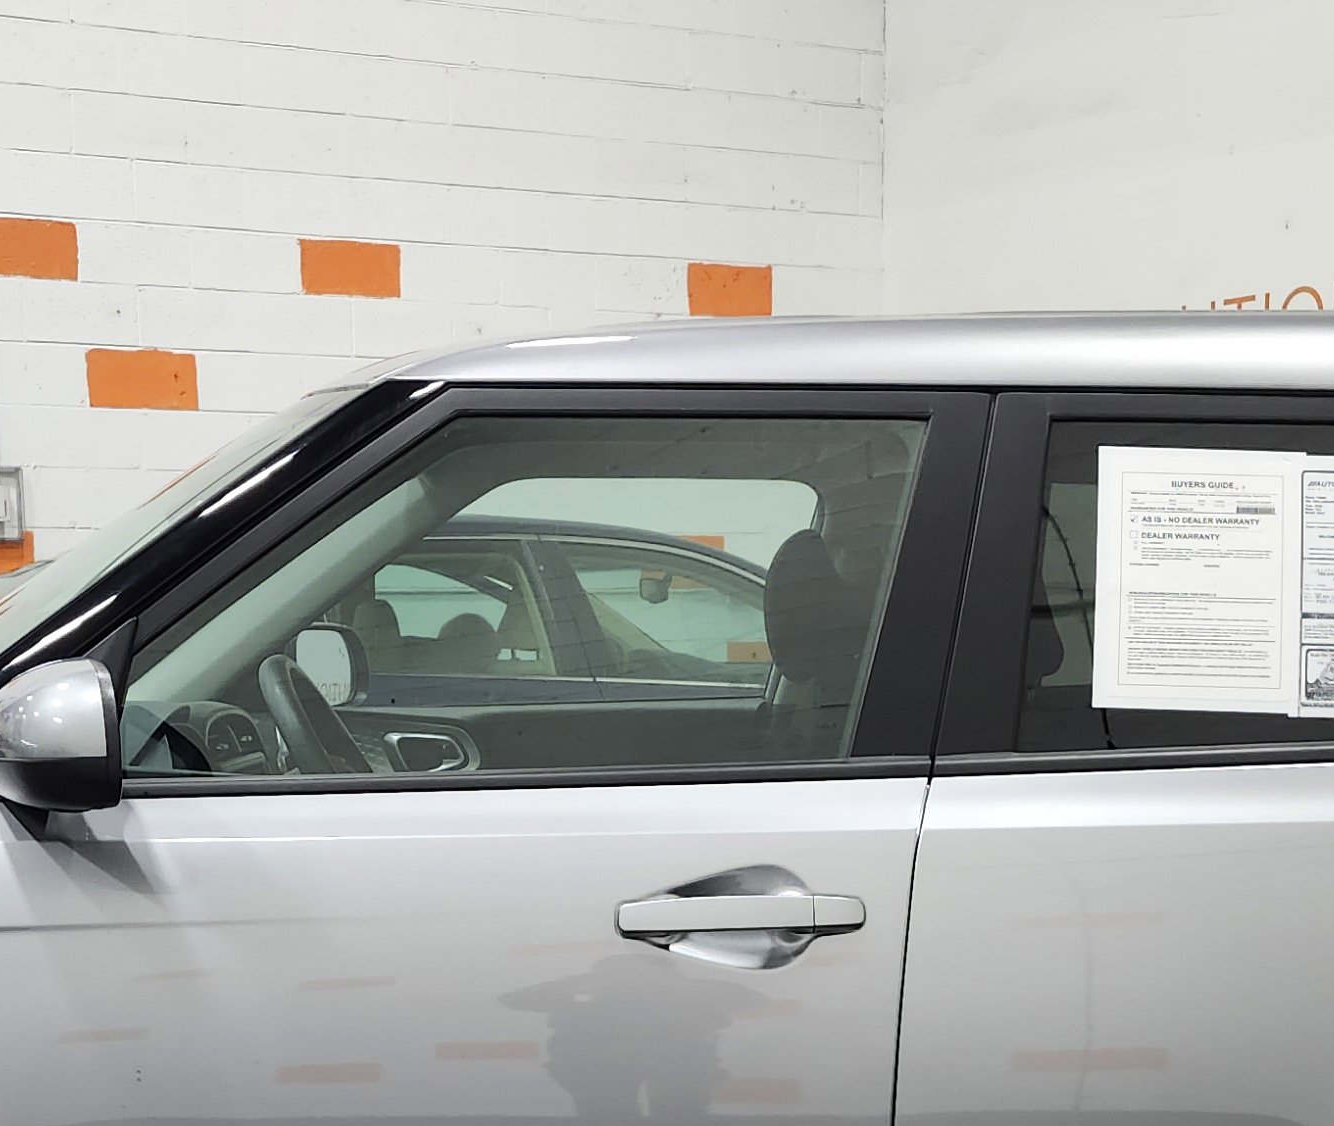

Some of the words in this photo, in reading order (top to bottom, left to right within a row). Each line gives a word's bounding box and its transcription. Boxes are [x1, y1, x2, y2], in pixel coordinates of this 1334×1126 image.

[1171, 480, 1206, 488] BUYERS
[1208, 481, 1234, 489] GUIDE
[1215, 518, 1260, 526] WARRANTY
[1141, 532, 1173, 540] DEALER
[1174, 533, 1220, 541] WARRANTY
